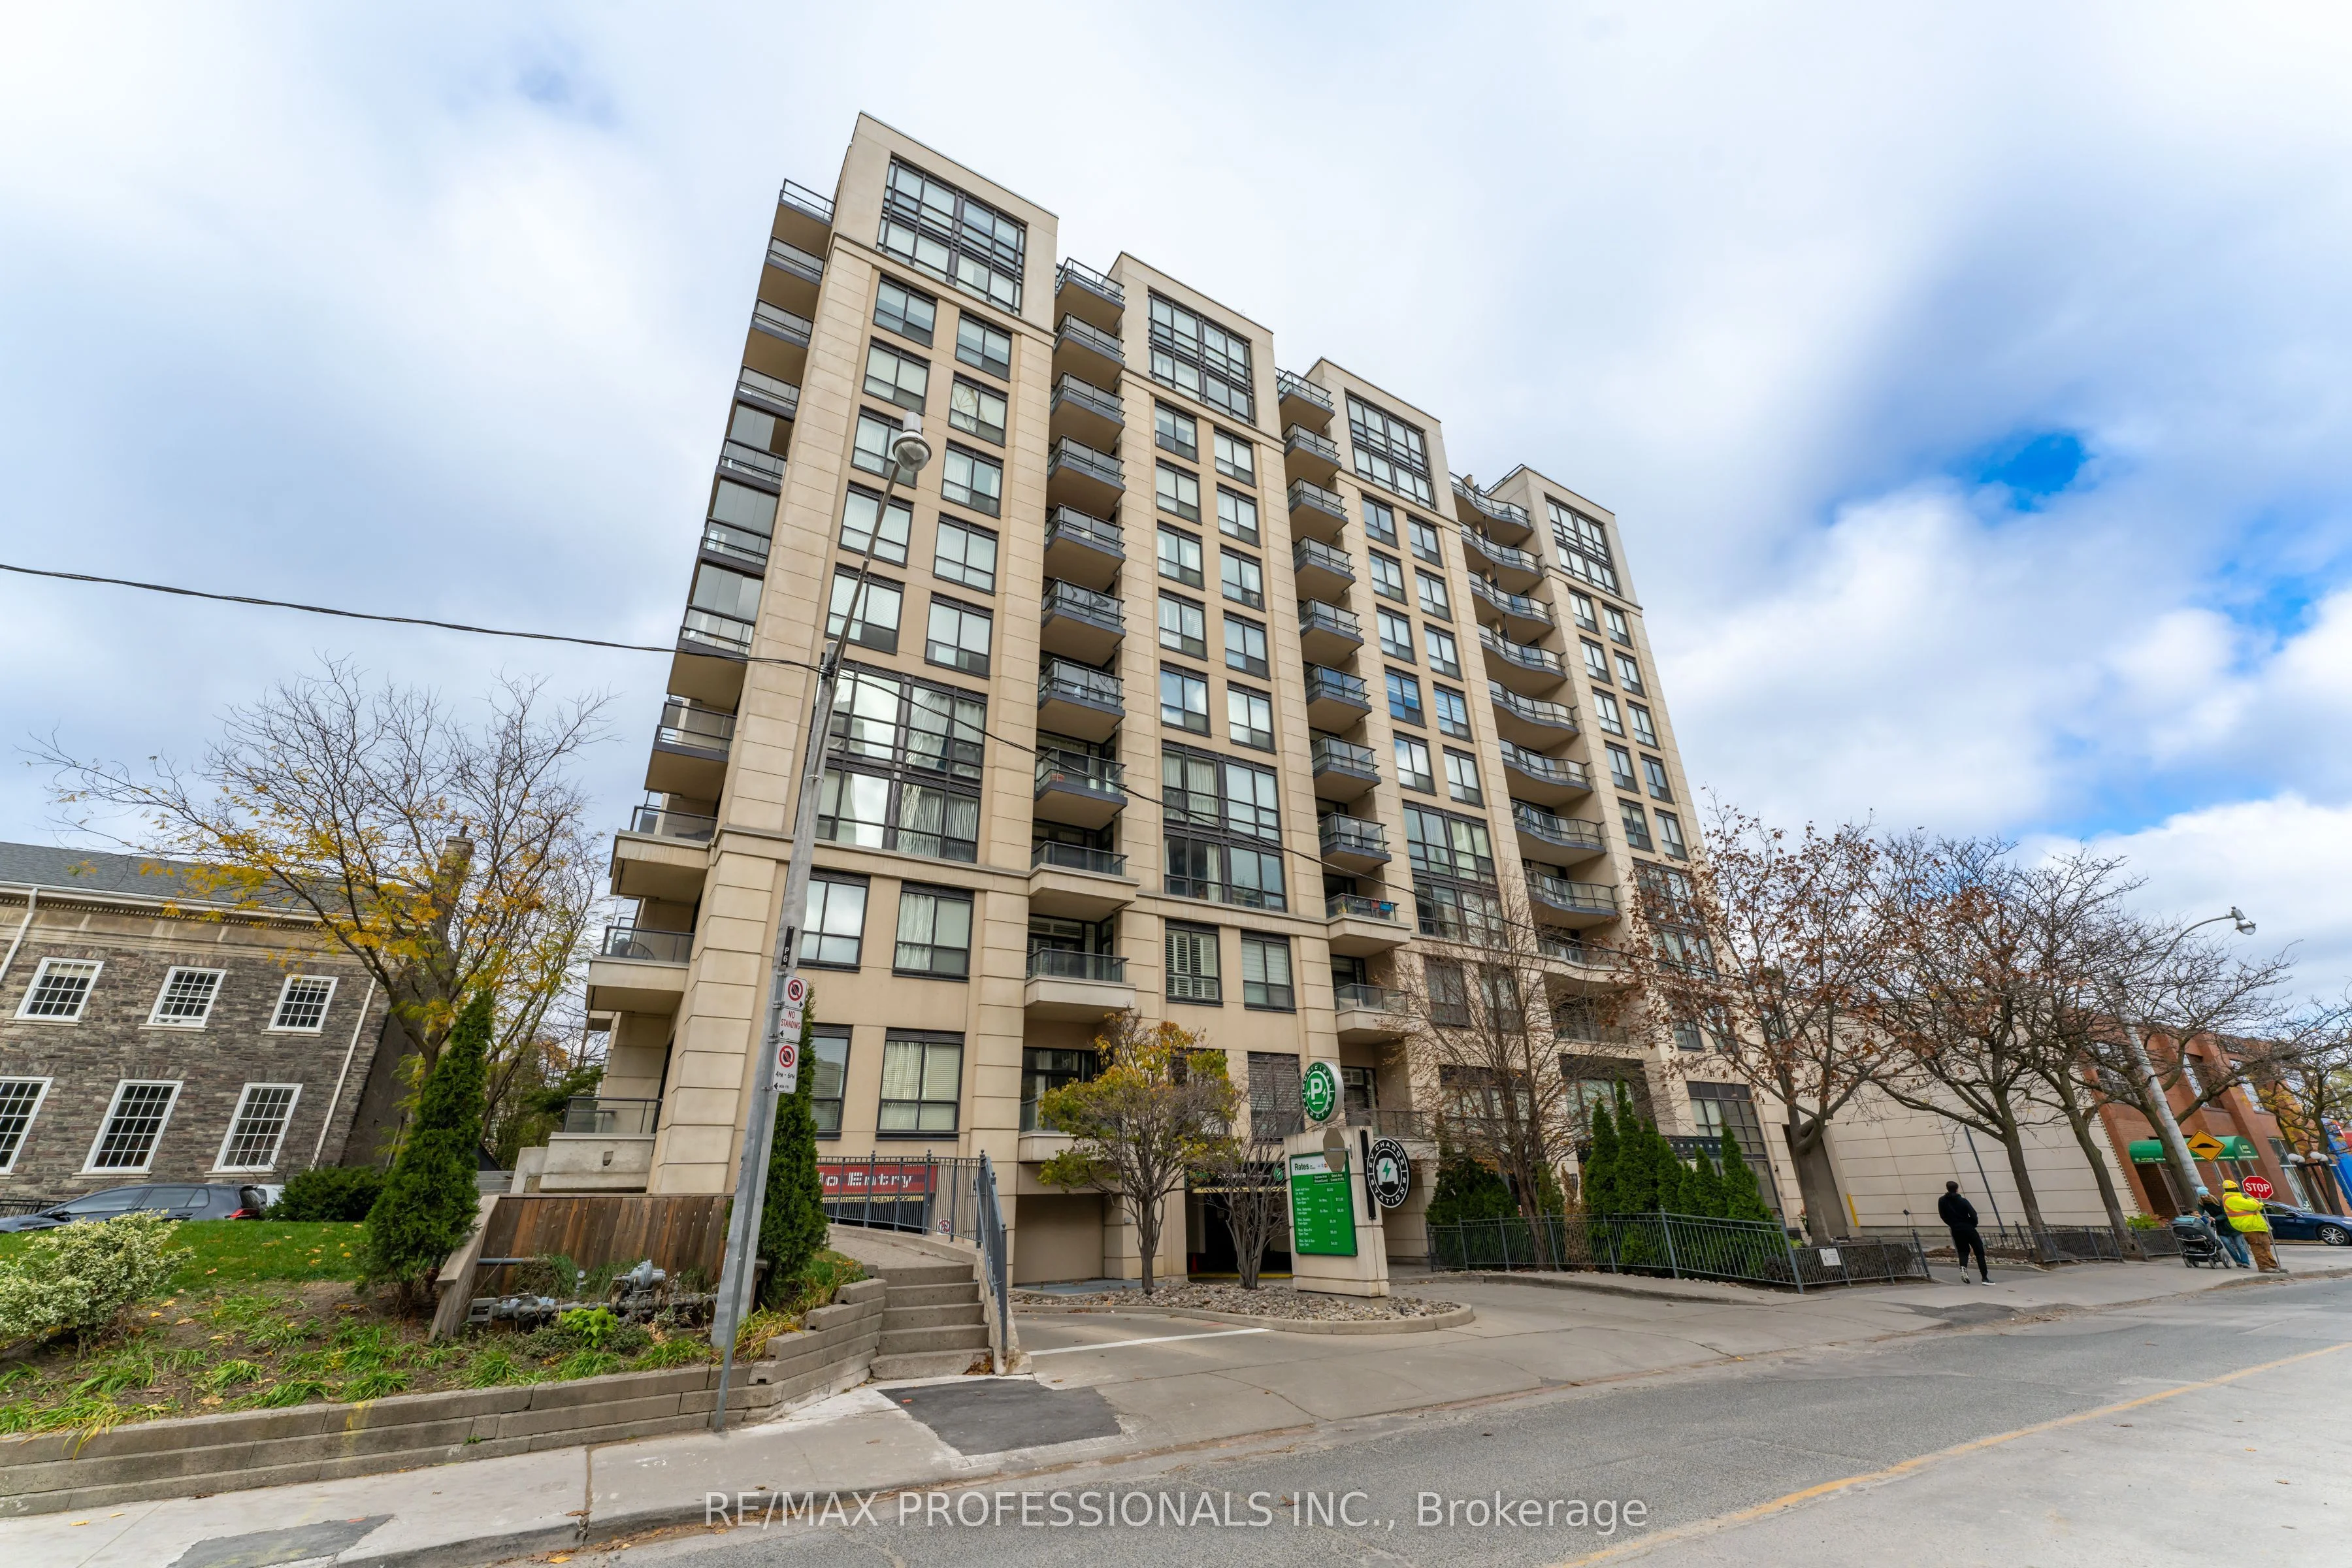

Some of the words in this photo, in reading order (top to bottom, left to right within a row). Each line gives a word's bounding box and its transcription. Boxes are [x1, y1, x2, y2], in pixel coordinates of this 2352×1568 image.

[781, 1019, 800, 1030] STANDING
[788, 1010, 795, 1019] NO
[1302, 1066, 1332, 1090] MUNICIPAL
[1311, 1078, 1323, 1100] P
[1303, 1098, 1332, 1119] PARKING
[1375, 1142, 1405, 1166] CHARGE
[847, 1172, 913, 1188] Entry
[1371, 1177, 1406, 1203] STATIONS
[2246, 1183, 2269, 1192] STOP
